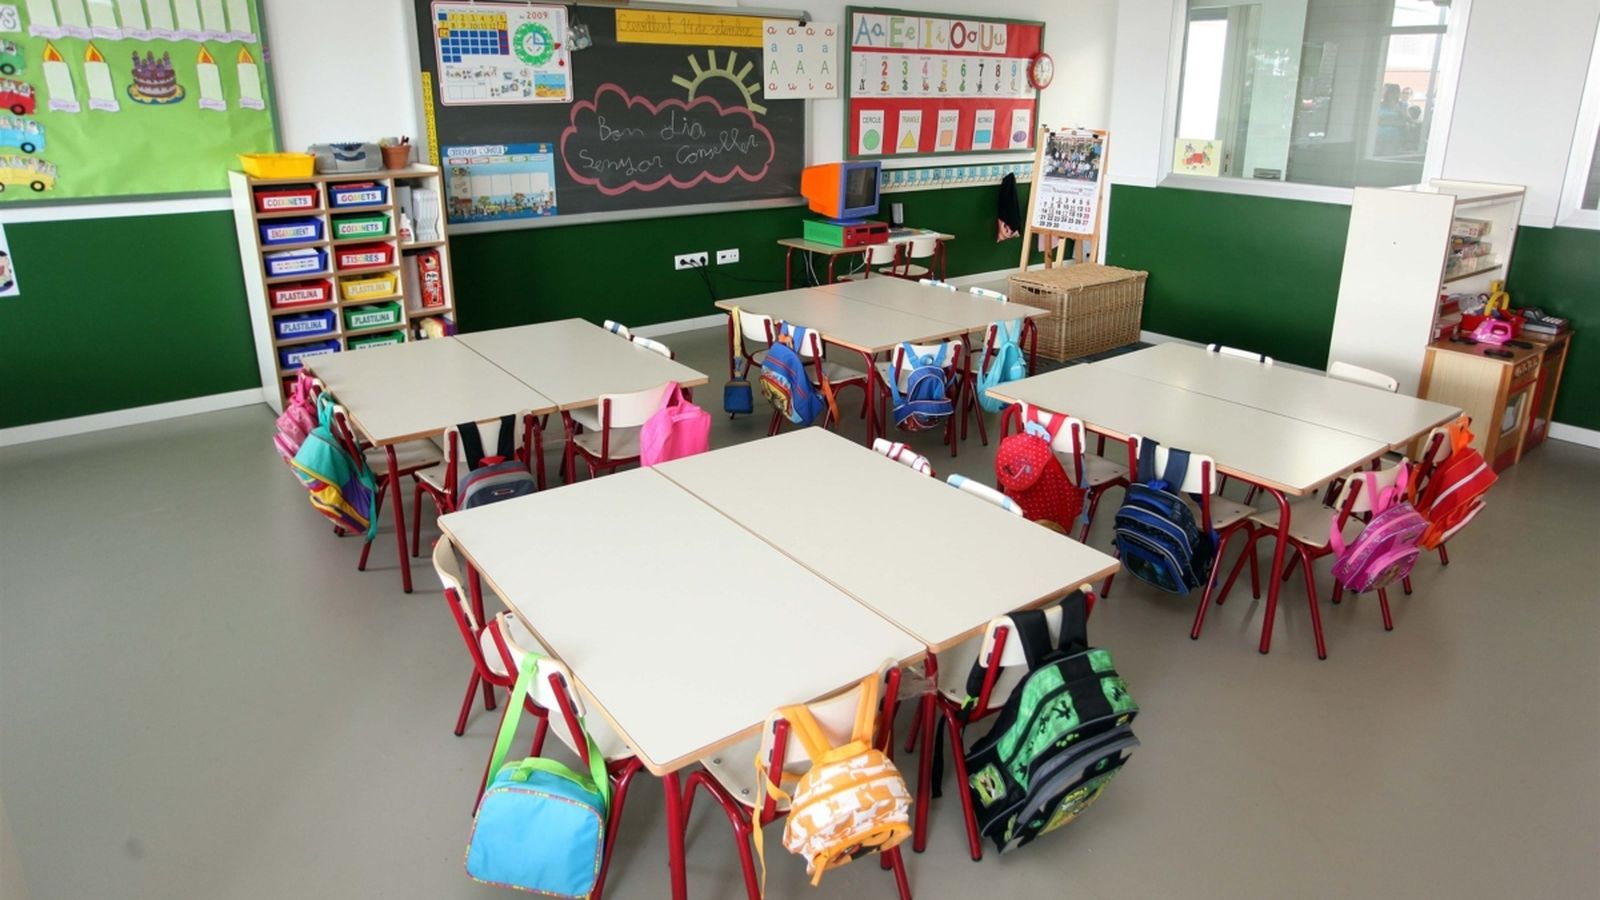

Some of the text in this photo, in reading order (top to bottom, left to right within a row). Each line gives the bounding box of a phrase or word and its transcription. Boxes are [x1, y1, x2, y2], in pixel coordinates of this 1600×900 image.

[0, 6, 16, 29] S
[526, 11, 548, 19] 2009
[767, 26, 834, 37] a a a a
[854, 16, 884, 46] Aa
[889, 17, 916, 48] Ee
[950, 22, 977, 49] Oo
[980, 24, 1005, 51] Uu
[771, 43, 829, 53] a a a
[770, 60, 829, 74] A A A
[882, 61, 888, 76] 2
[902, 61, 908, 75] 3
[922, 62, 928, 76] 4
[942, 63, 948, 78] 5
[961, 64, 966, 77] 6
[979, 64, 984, 77] 7
[995, 64, 1000, 77] 8
[1012, 64, 1016, 77] 9
[768, 78, 834, 91] a u i a
[597, 110, 706, 141] Bon dia
[579, 128, 758, 176] Senyor Conseller
[341, 193, 376, 202] GOMETS
[351, 283, 386, 294] PLASTILINA
[280, 290, 317, 301] PLASTILINA
[356, 314, 390, 324] PLASTILINA
[284, 322, 322, 332] PLASTILINA
